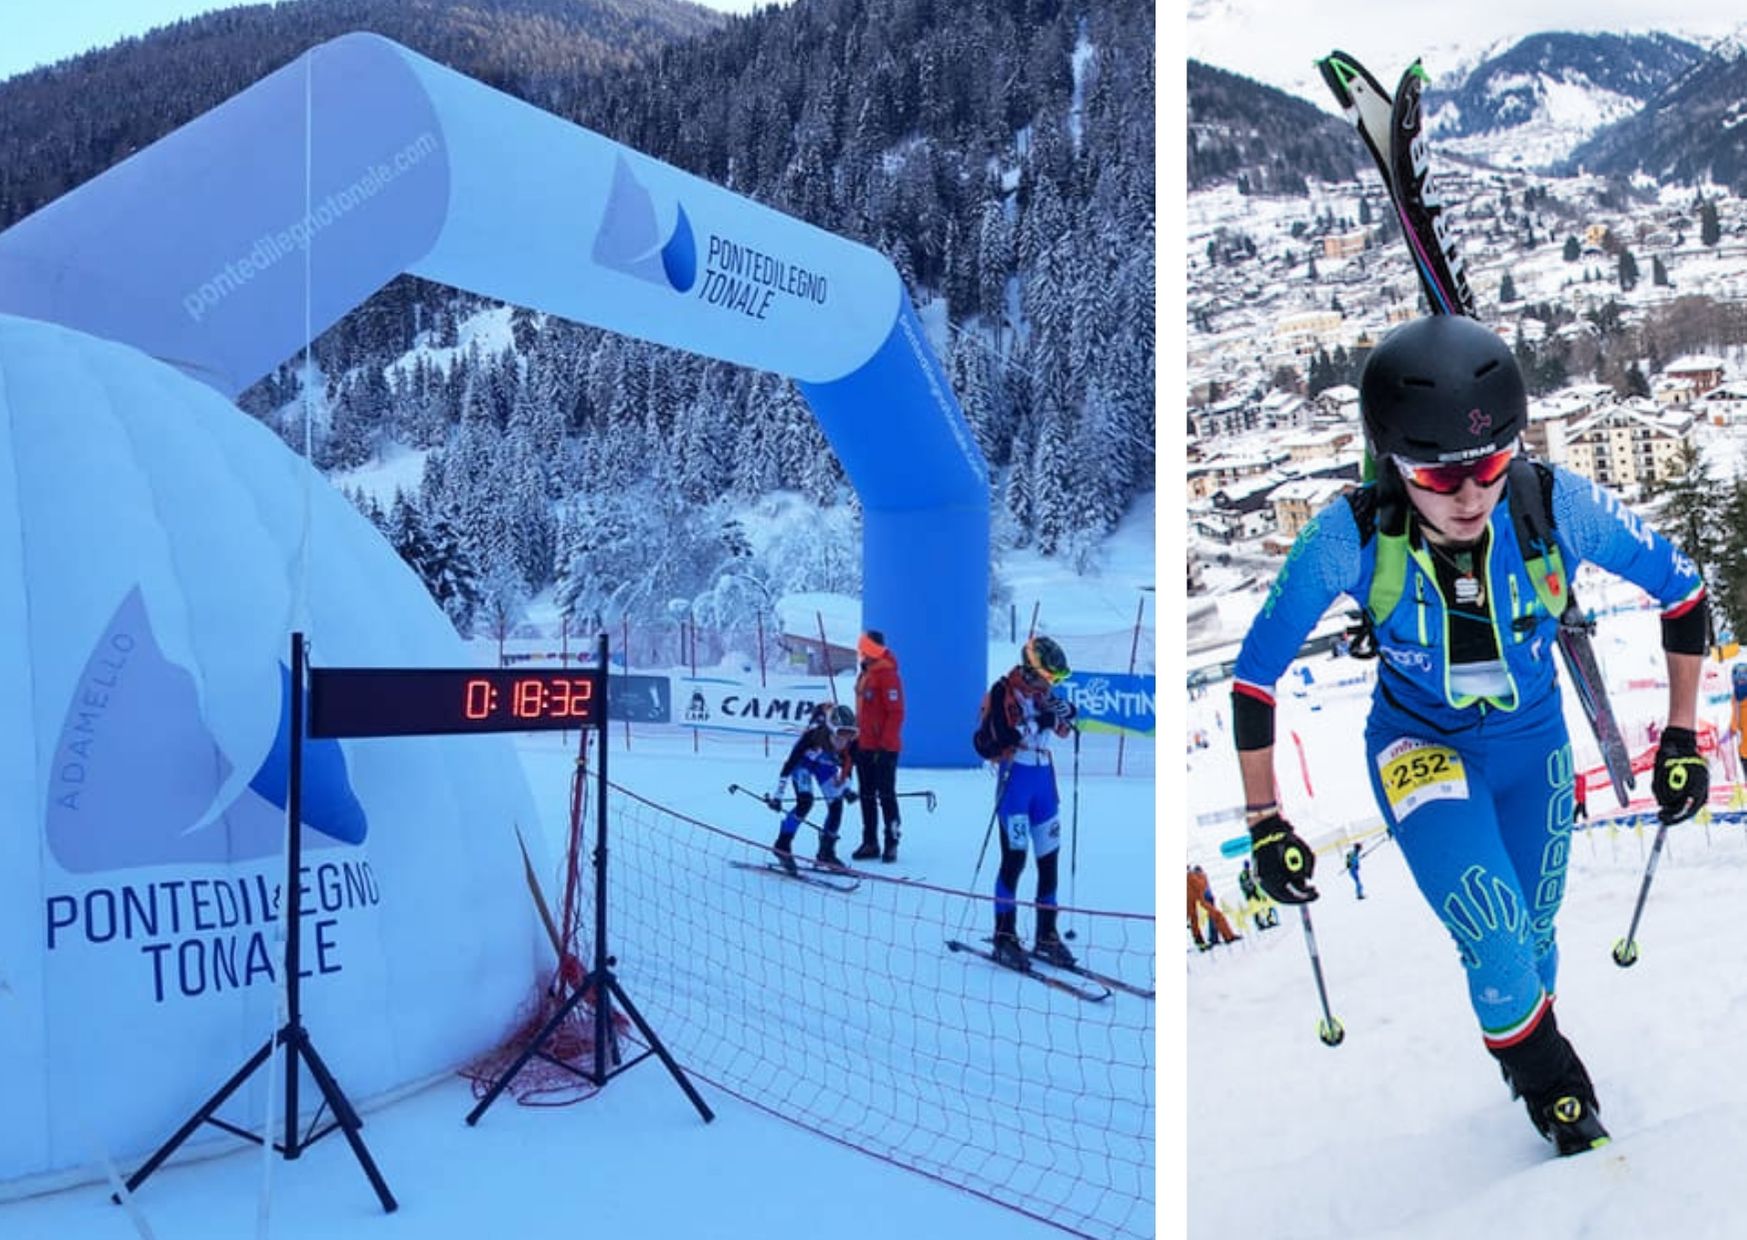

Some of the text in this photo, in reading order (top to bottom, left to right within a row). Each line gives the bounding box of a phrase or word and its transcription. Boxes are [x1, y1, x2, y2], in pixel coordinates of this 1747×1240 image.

[183, 131, 440, 322] pontedilegnotonale.com
[698, 268, 776, 320] TONALE
[708, 234, 828, 305] PONTEDILEGNO
[58, 632, 136, 812] ADAMELLO
[466, 680, 593, 719] 0:18:32
[720, 696, 816, 721] CAMP
[1392, 753, 1451, 790] 252
[141, 919, 343, 1003] TONAE
